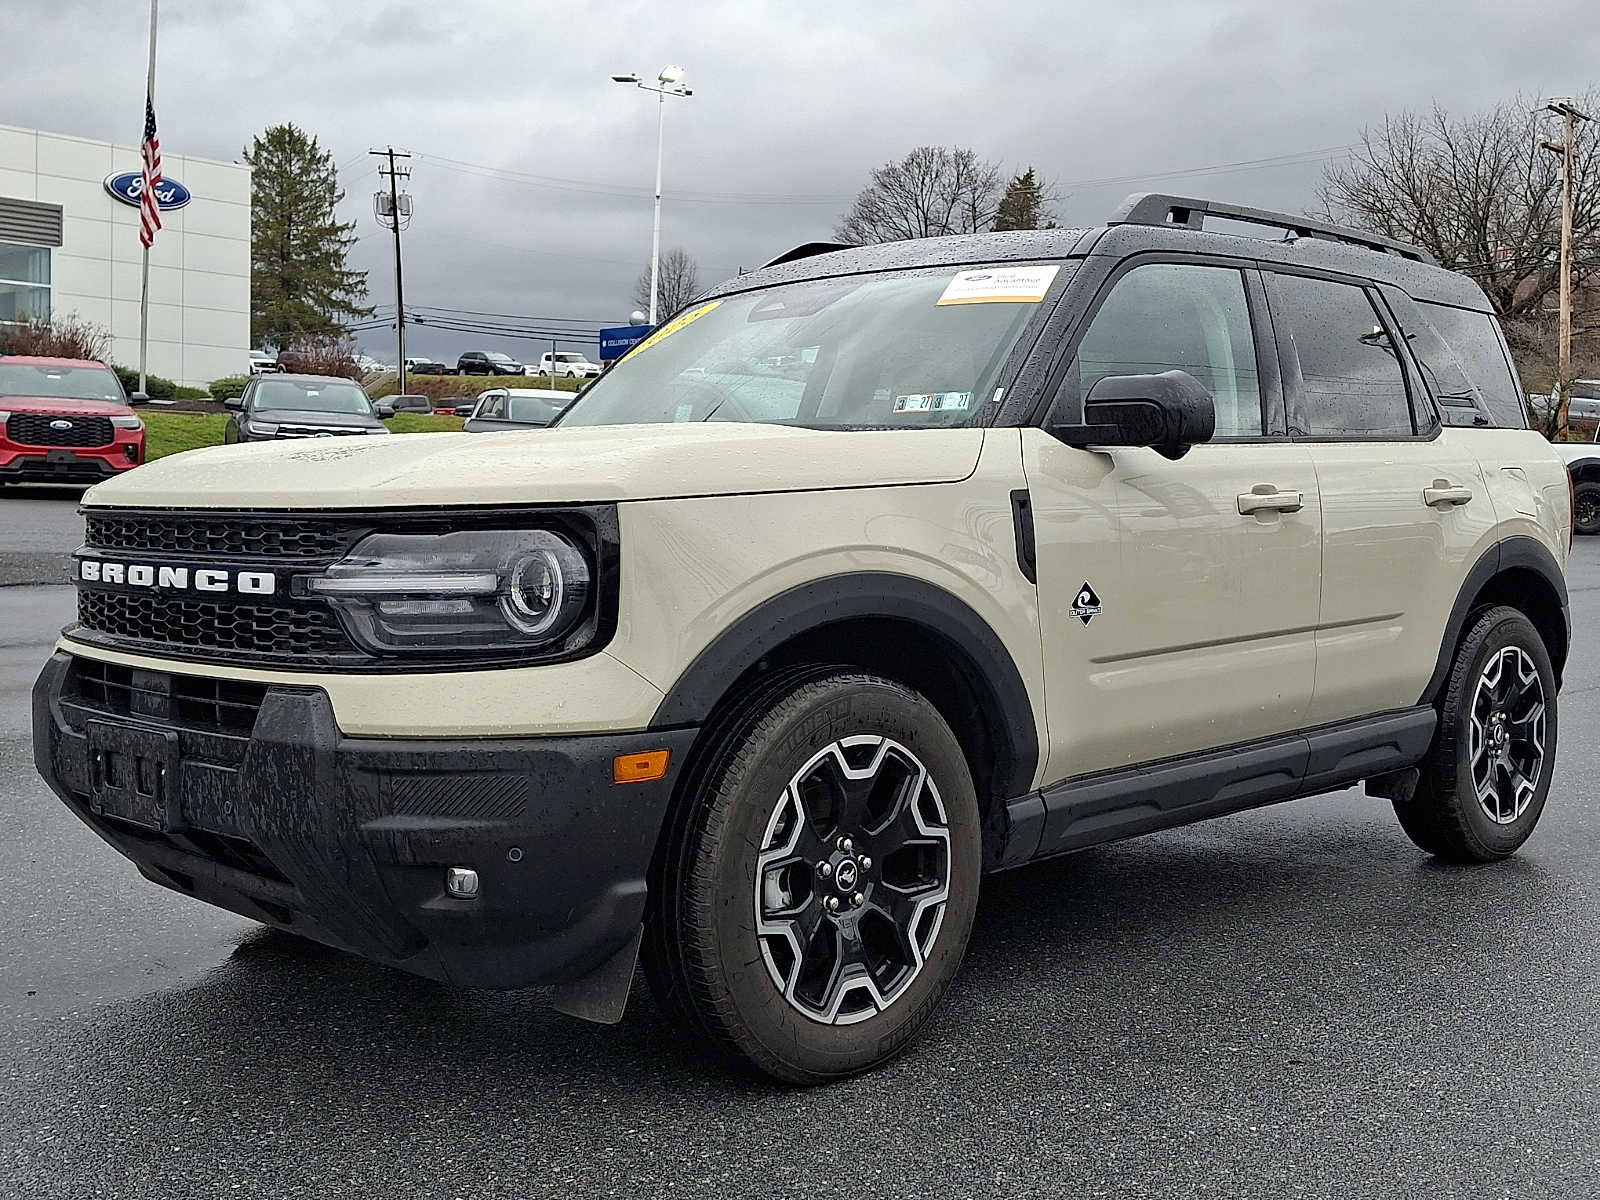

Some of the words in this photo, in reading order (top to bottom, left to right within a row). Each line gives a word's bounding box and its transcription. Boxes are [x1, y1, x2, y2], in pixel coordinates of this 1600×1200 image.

[920, 396, 930, 409] 27
[958, 395, 968, 408] 27
[81, 560, 276, 595] BRONCO
